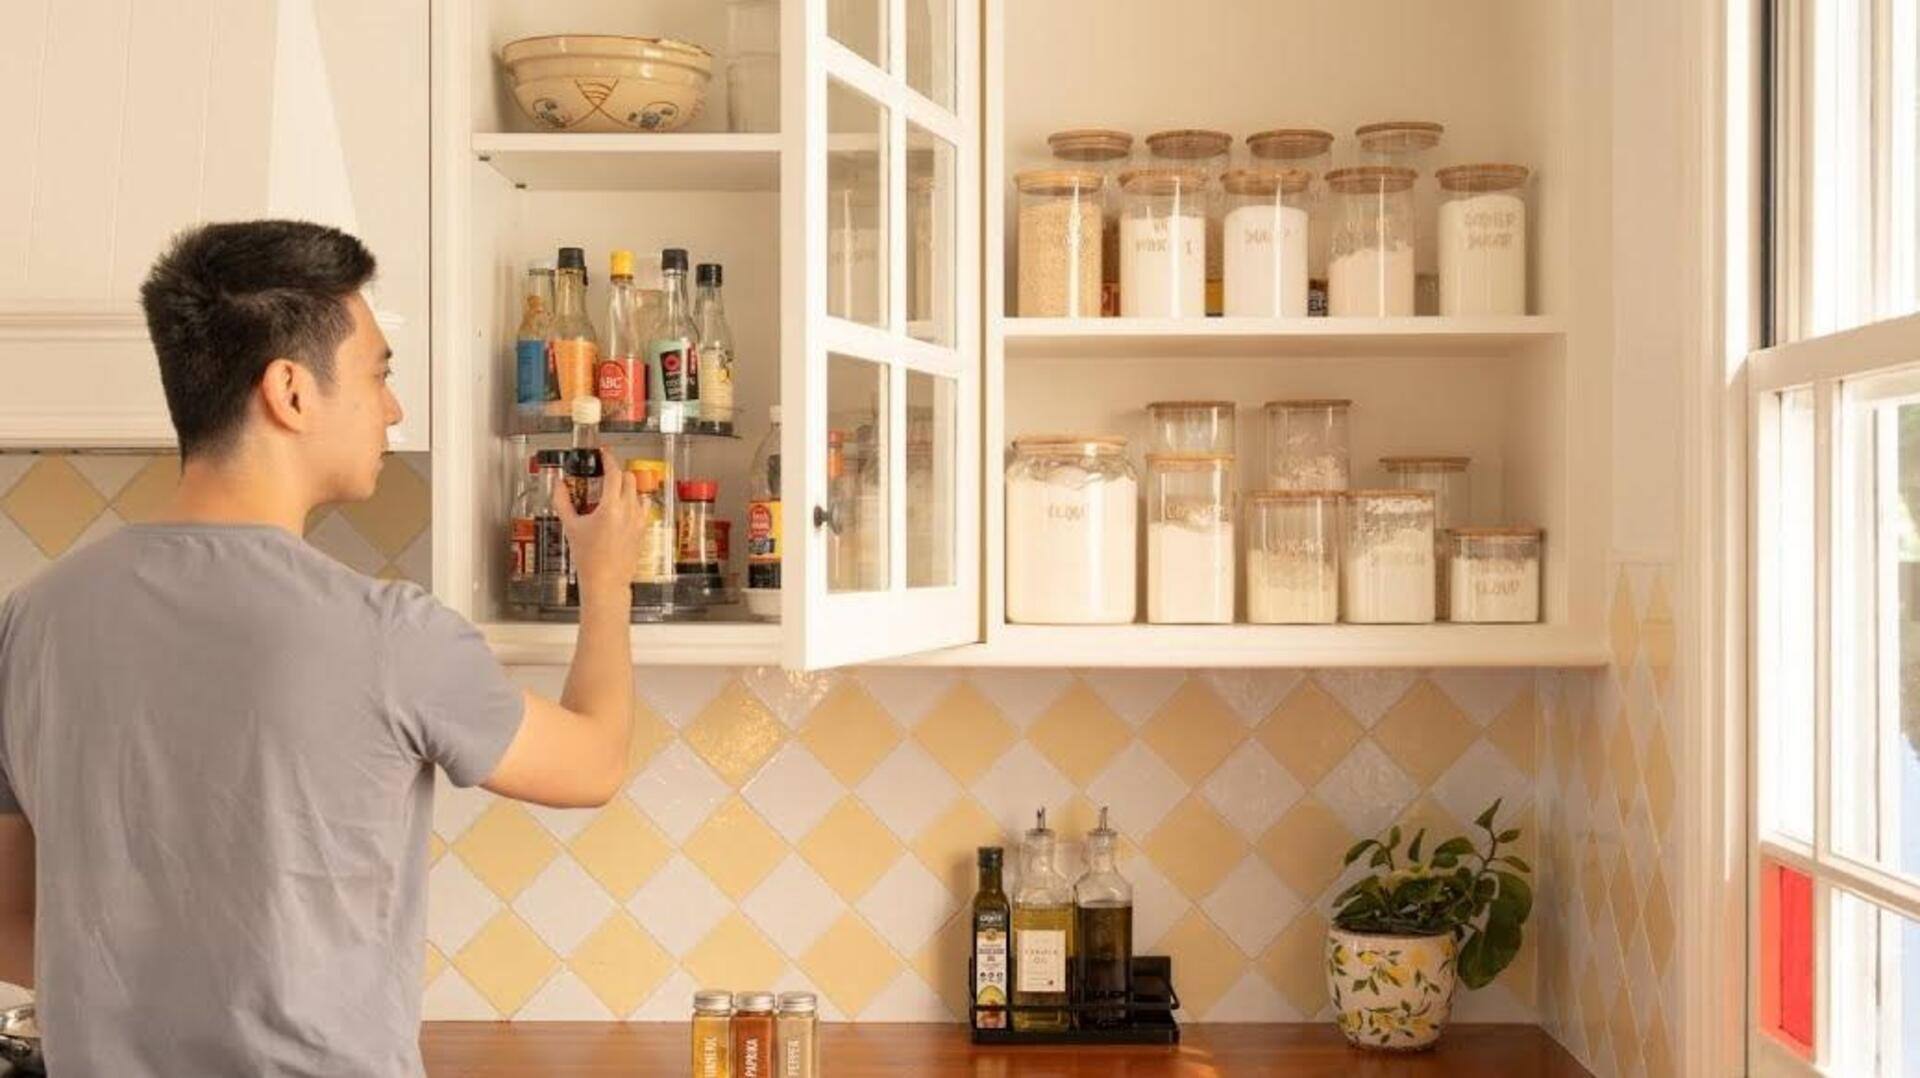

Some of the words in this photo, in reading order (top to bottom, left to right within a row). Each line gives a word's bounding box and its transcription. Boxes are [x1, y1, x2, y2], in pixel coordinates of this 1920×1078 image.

[600, 376, 622, 389] ABC
[704, 1037, 717, 1078] URMERIC
[745, 1038, 758, 1078] PAPRIKA
[787, 1039, 800, 1077] PEPPER
